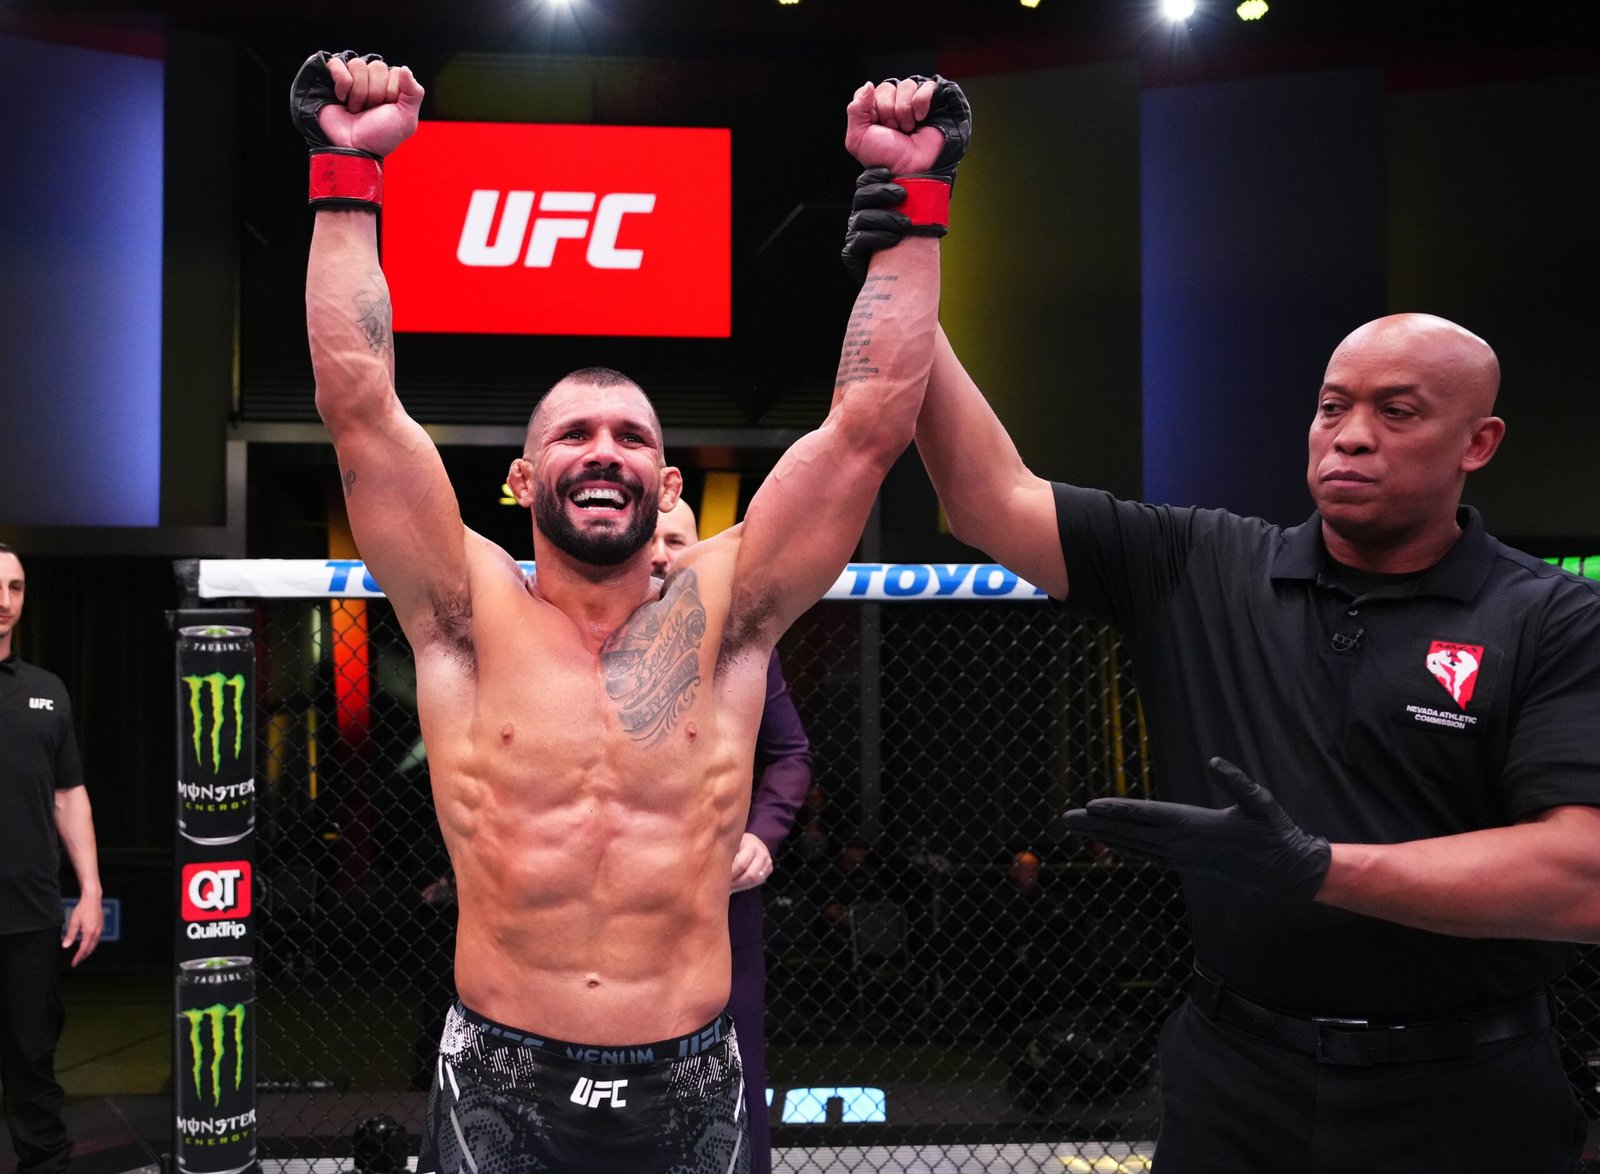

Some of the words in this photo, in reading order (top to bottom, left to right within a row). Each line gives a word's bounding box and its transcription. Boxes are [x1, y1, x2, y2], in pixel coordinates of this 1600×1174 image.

[456, 189, 657, 270] UFC
[846, 564, 1046, 597] TOYO
[29, 697, 54, 711] UFC
[1406, 705, 1438, 717] NEVADA
[1439, 711, 1477, 724] ATHLETIC
[1415, 714, 1465, 729] COMMISSION
[177, 779, 255, 801] MONSTER
[186, 800, 248, 811] ENERGY
[188, 869, 241, 910] QT
[186, 921, 247, 939] QuikTrip
[570, 1076, 629, 1109] UFC
[177, 1109, 256, 1136] MONSTER
[185, 1131, 248, 1146] ENERGY
